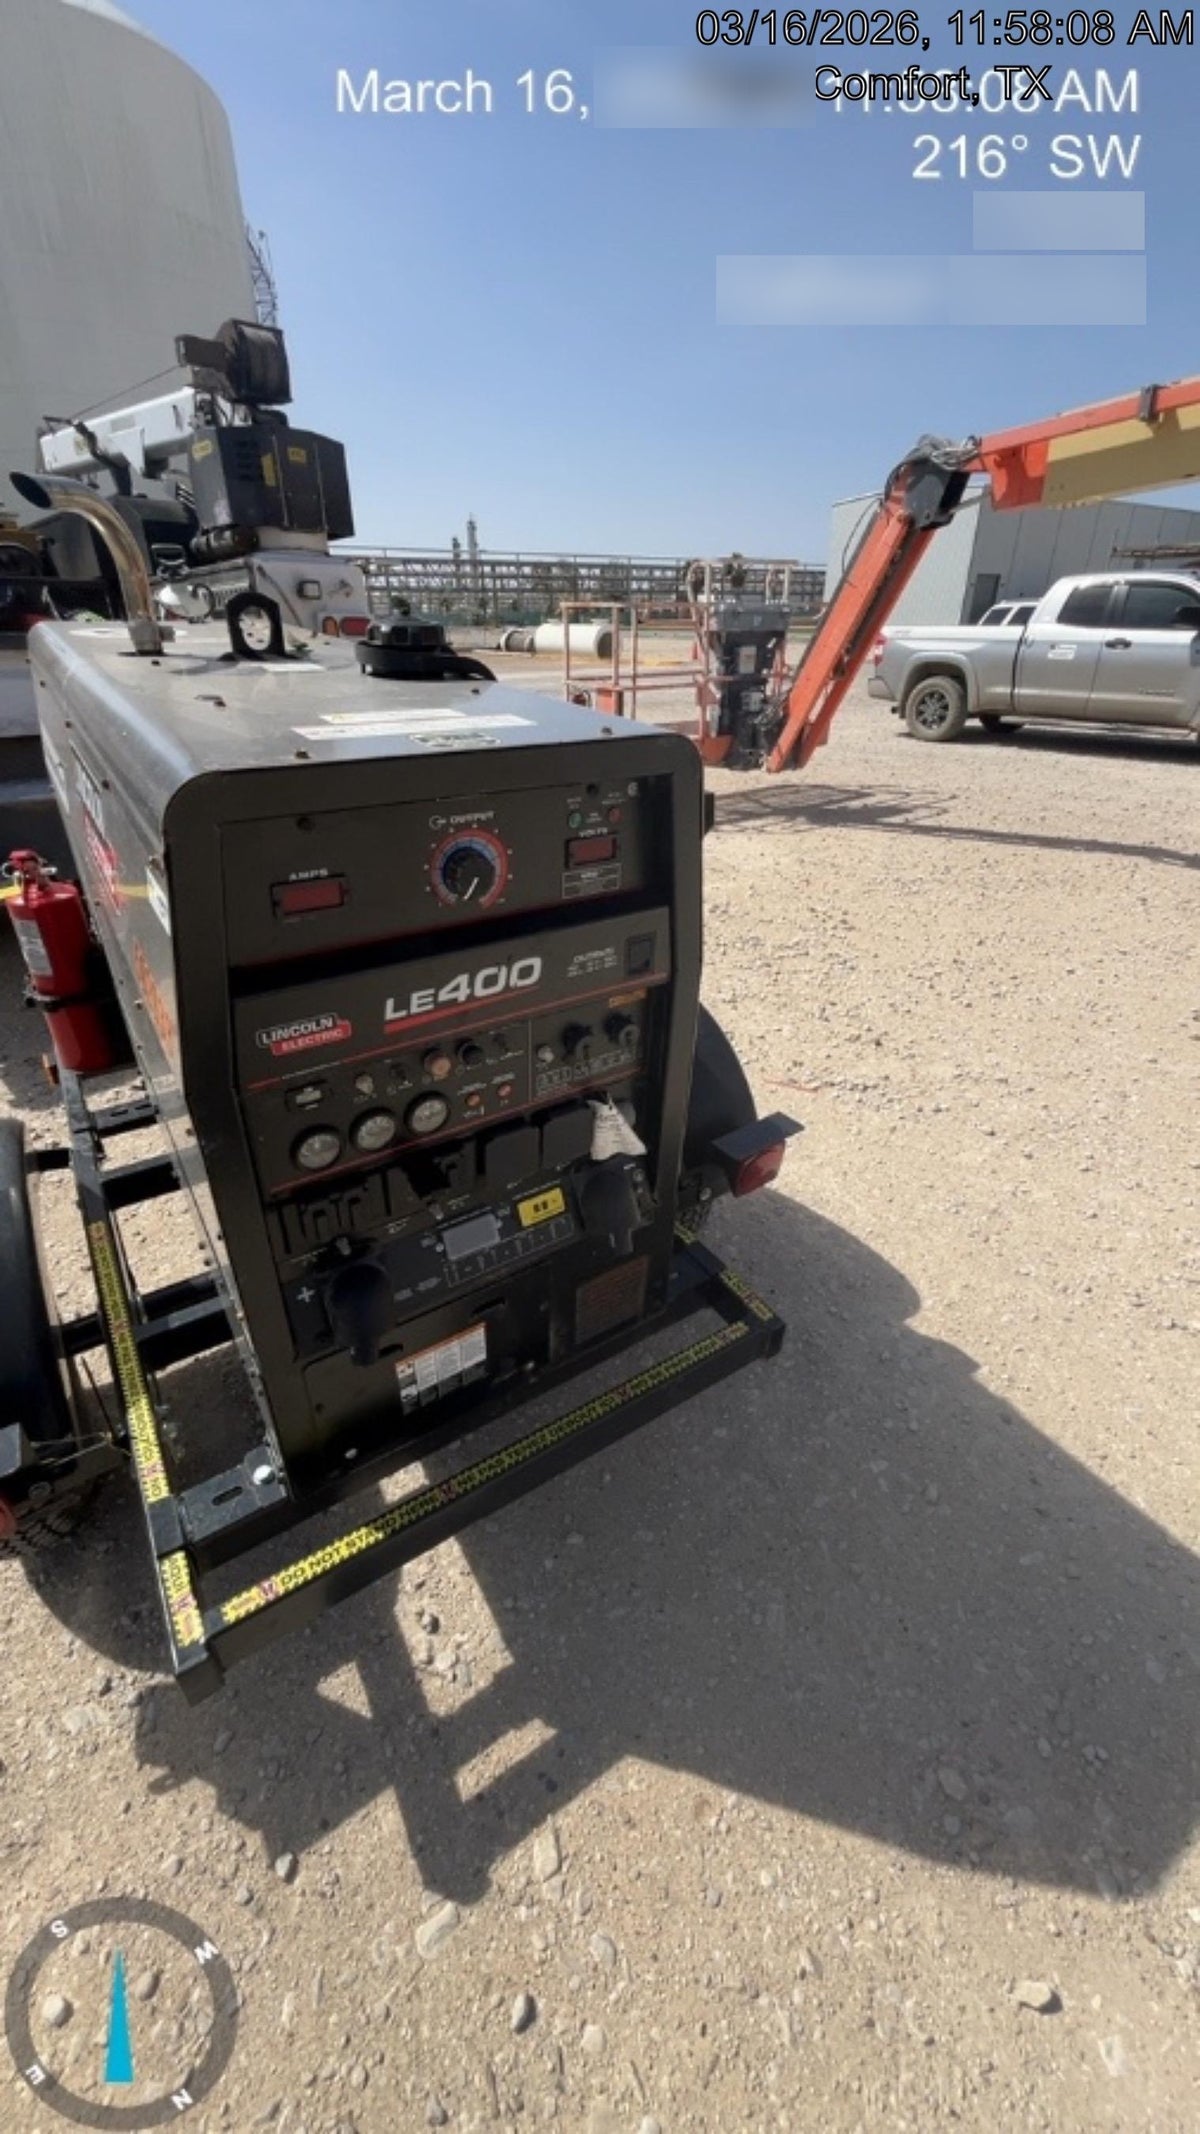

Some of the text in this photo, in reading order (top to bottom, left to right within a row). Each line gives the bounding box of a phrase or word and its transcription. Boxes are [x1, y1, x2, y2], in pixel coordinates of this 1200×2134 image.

[288, 868, 328, 881] AMPS
[384, 957, 542, 1021] LE400
[262, 1017, 334, 1044] LINCOLN
[282, 1028, 343, 1050] ELECTRIC
